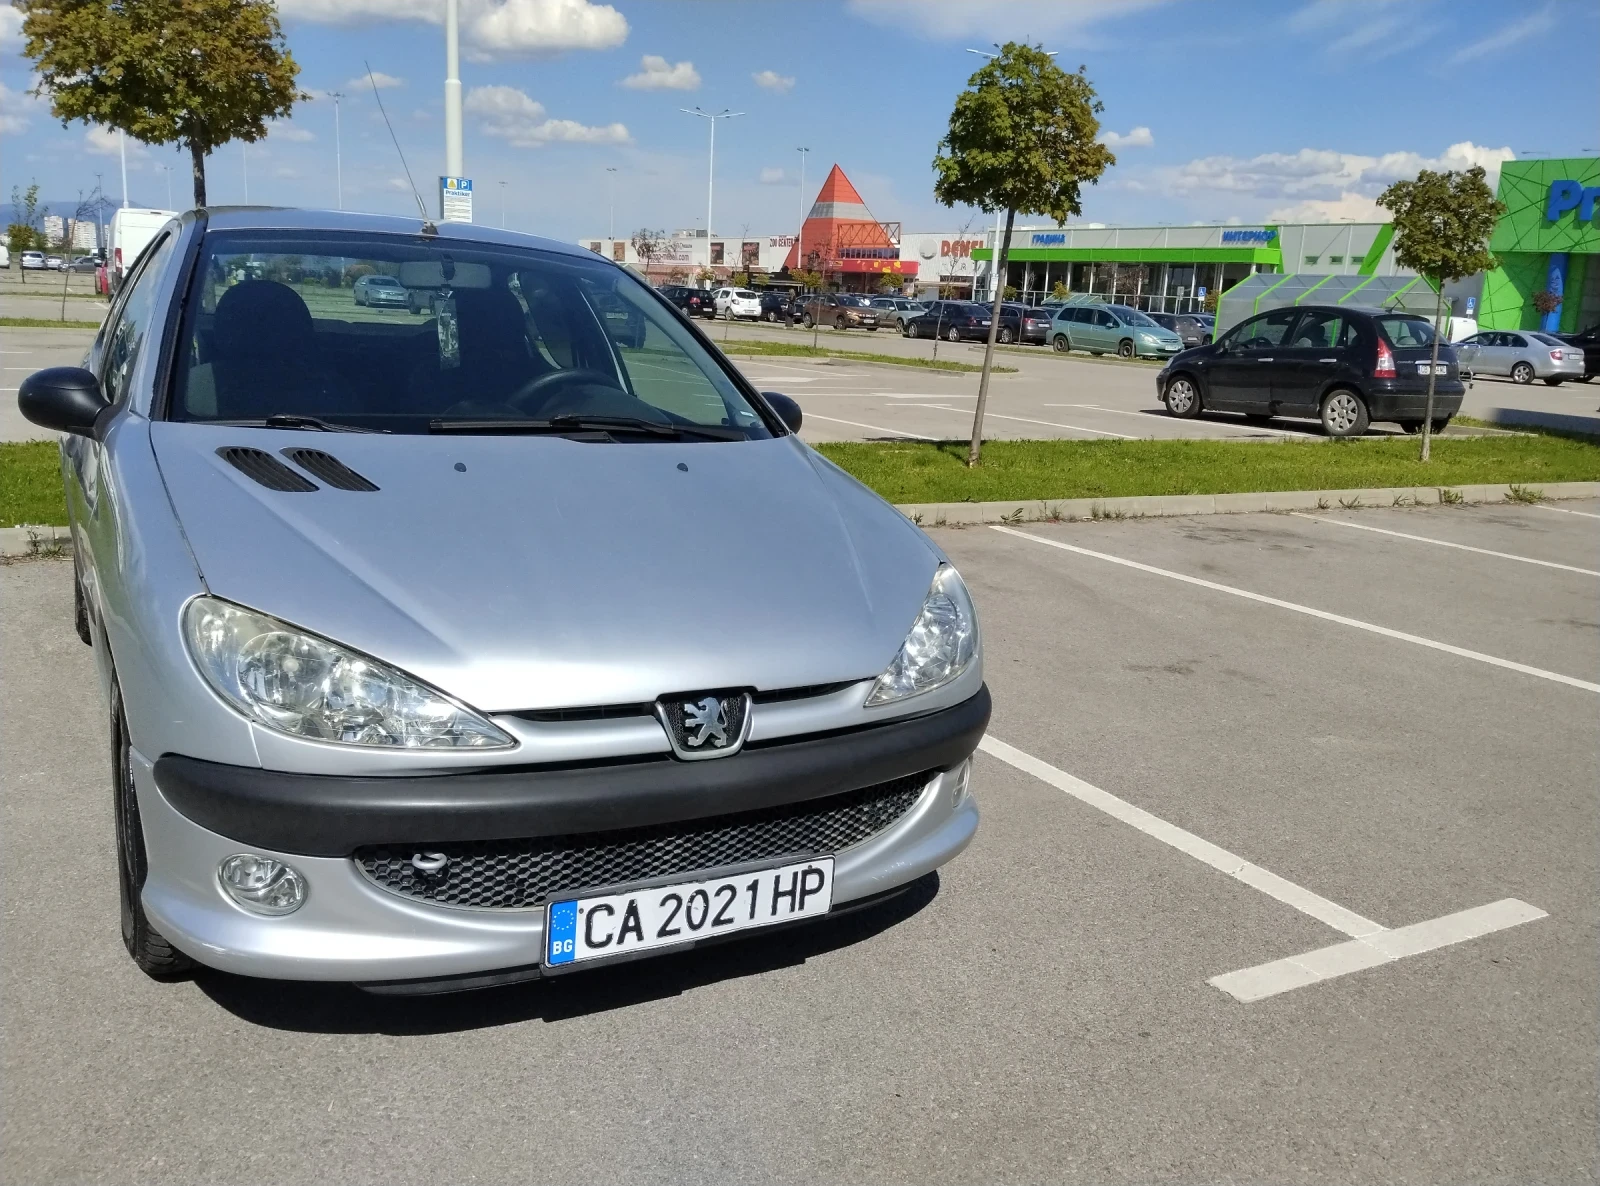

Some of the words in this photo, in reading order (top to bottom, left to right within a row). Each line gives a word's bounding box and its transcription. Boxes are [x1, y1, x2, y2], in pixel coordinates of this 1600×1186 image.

[1031, 234, 1065, 244] ГРАДИНА
[1222, 230, 1276, 241] ИНТЕРИОР
[584, 899, 645, 949] CA
[656, 879, 760, 938] 2021
[770, 867, 825, 916] HP
[552, 939, 573, 955] BG
